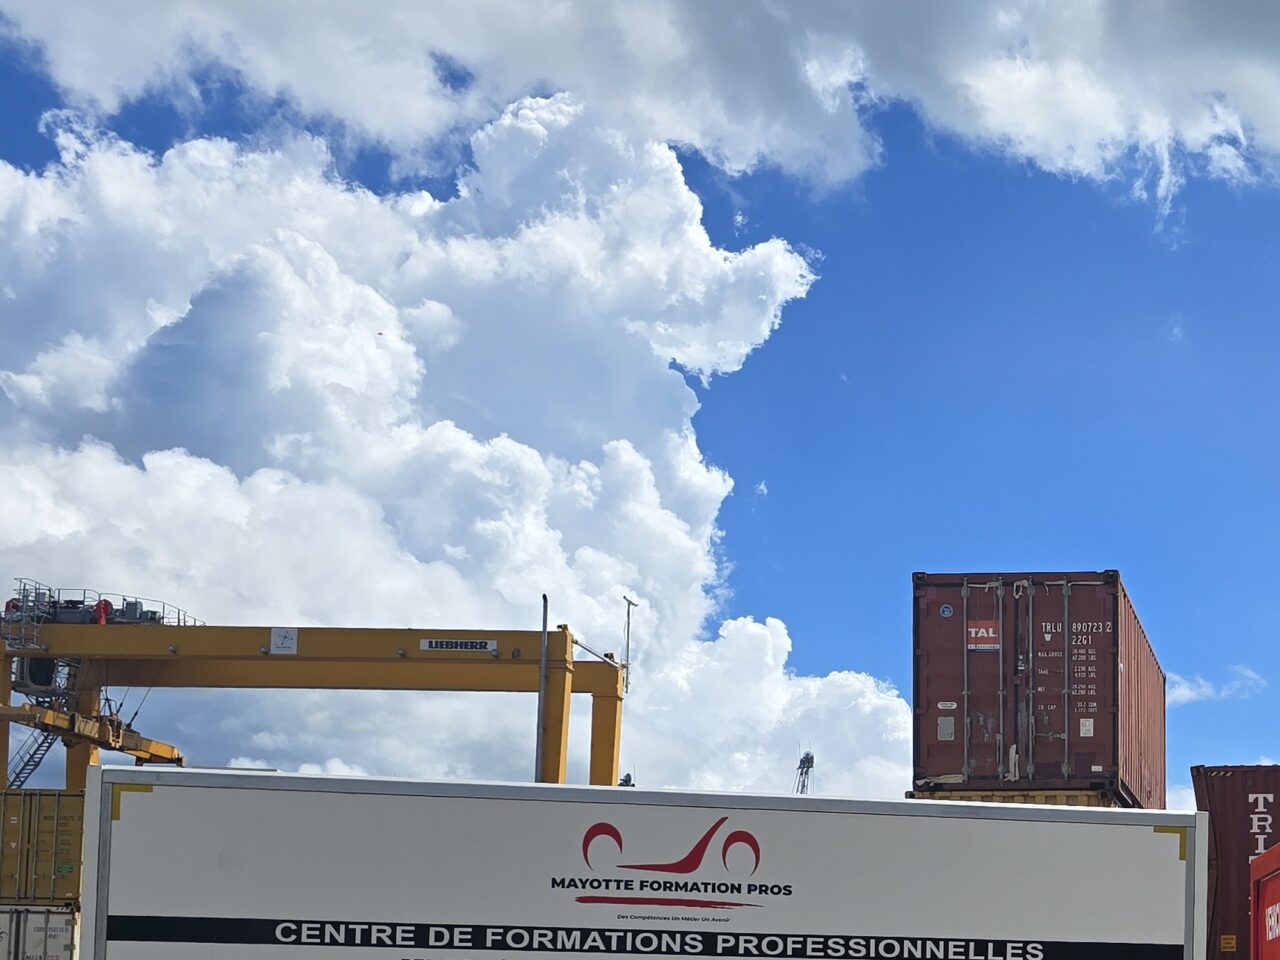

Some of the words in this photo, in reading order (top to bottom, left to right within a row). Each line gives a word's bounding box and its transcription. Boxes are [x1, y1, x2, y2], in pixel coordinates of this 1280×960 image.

[1042, 622, 1062, 633] TRLU
[1072, 622, 1103, 633] 890723
[1106, 622, 1112, 633] 2
[968, 628, 998, 638] TAL
[428, 640, 489, 650] LIEBHERR
[1072, 635, 1092, 645] 22G1
[551, 877, 634, 890] MAYOTTE
[639, 880, 741, 894] FORMATION
[747, 883, 792, 895] PROS
[275, 922, 415, 945] CENTRE
[429, 927, 472, 946] DE
[486, 928, 703, 952] FORMATIONS
[716, 935, 1043, 960] PROFESSIONNELLES
